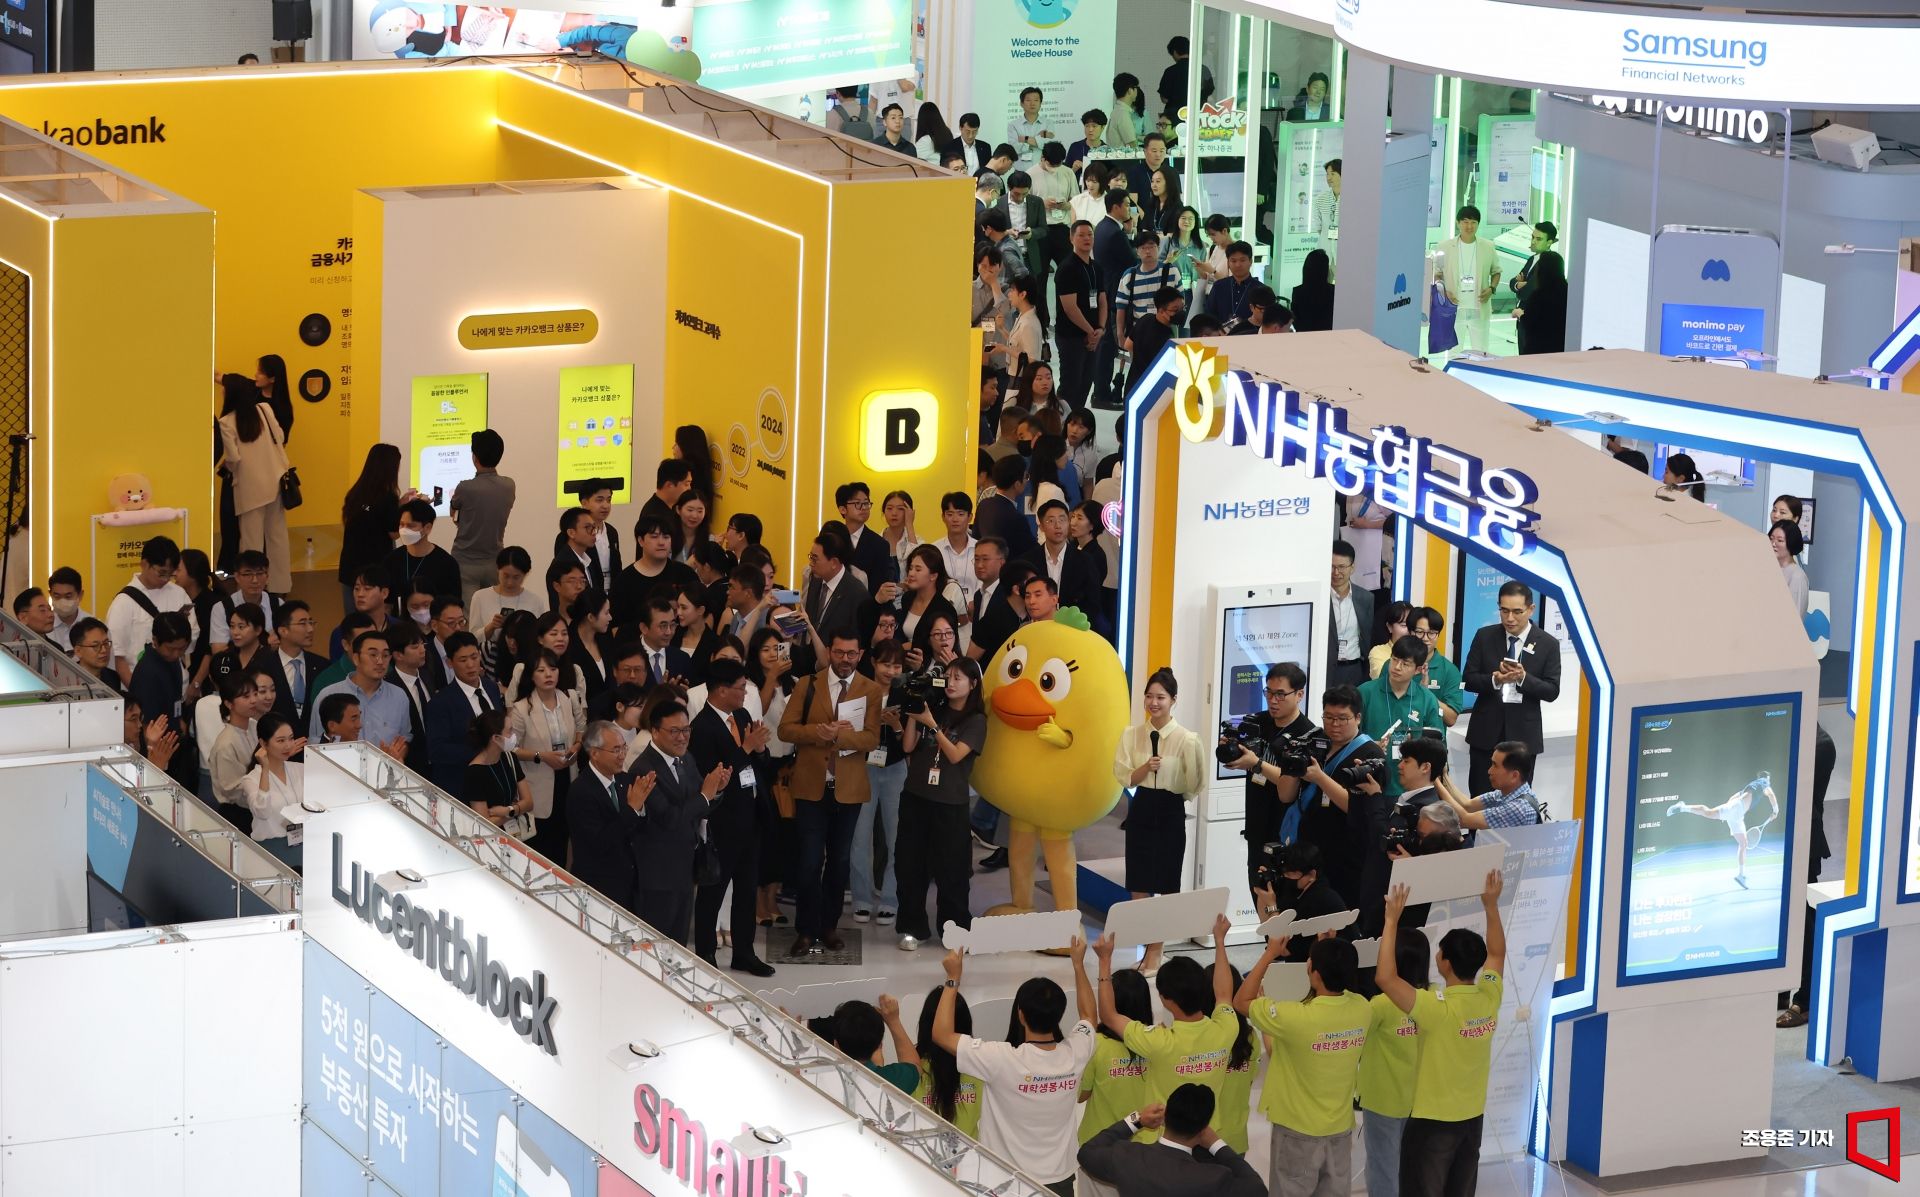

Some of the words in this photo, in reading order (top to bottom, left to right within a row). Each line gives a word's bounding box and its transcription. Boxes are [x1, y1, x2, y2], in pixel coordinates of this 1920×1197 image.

[1011, 38, 1053, 47] Welcome
[1055, 37, 1064, 46] to
[1065, 36, 1080, 45] the
[1622, 28, 1767, 67] Samsung
[1011, 49, 1043, 58] WeBee
[1044, 48, 1073, 57] House
[1622, 67, 1680, 82] Financial
[1683, 71, 1745, 86] Networks
[1199, 110, 1243, 129] TOCK
[33, 116, 166, 147] kaobank
[1387, 295, 1411, 311] monimo
[472, 327, 496, 338] 나에게
[497, 326, 513, 337] 맞는
[515, 324, 555, 336] 카카오뱅크
[556, 322, 585, 334] 상품은?
[1682, 319, 1726, 331] monimo
[1727, 322, 1745, 333] pay
[1692, 334, 1732, 343] 오프라인에서도
[581, 385, 599, 393] 나에게
[571, 395, 599, 404] 카카오뱅크
[600, 394, 621, 402] 상품은?
[761, 414, 783, 436] 2024
[885, 407, 921, 456] B
[731, 442, 746, 458] 2022
[1223, 369, 1537, 558] NH농협금융
[1204, 497, 1310, 521] NH농협은행
[332, 831, 558, 1057] Lucentblock
[321, 994, 348, 1054] 5천
[352, 1018, 404, 1094] 원으로
[408, 1063, 480, 1156] 시작하는
[1018, 1079, 1077, 1094] 대학생봉사단
[320, 1052, 368, 1132] 부동산
[373, 1095, 408, 1163] 투자
